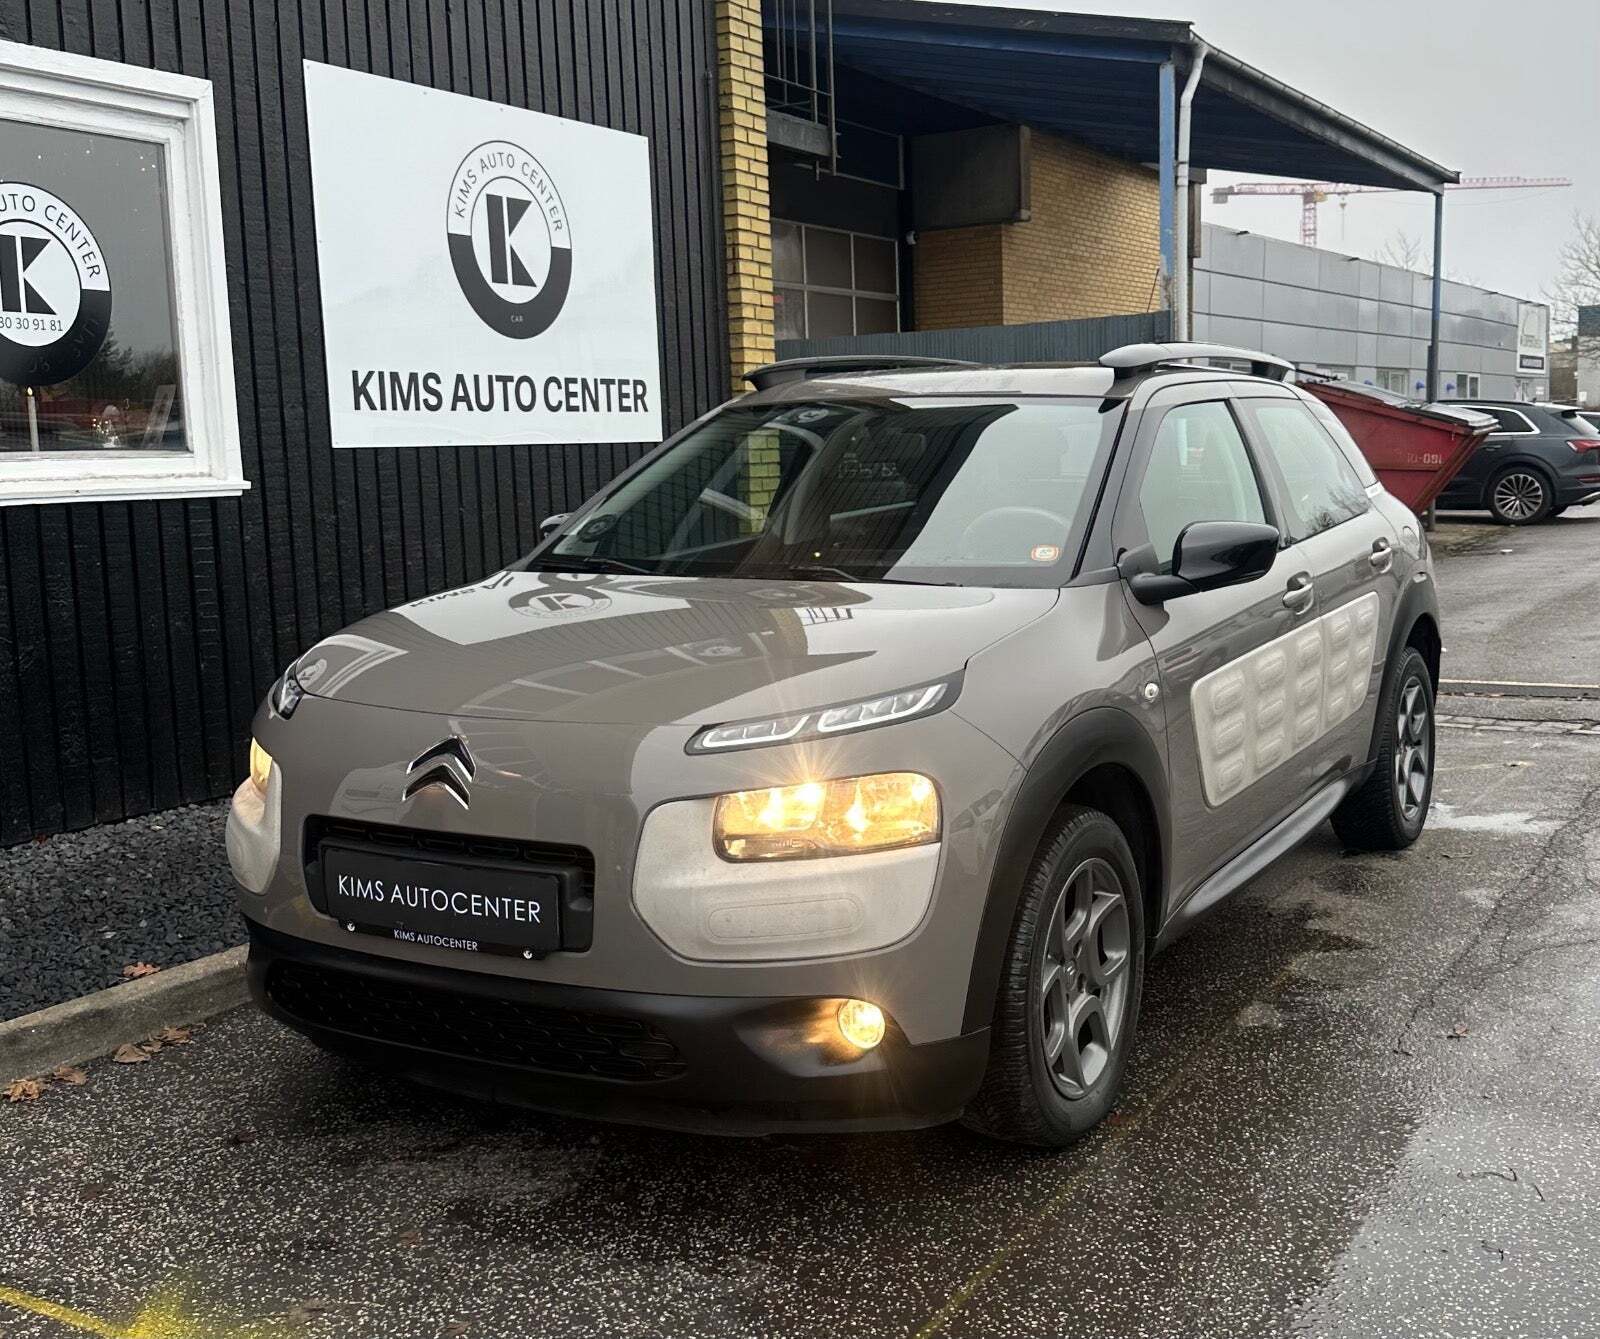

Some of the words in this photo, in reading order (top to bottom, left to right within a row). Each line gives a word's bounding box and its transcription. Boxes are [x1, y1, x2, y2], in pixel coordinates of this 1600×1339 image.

[455, 169, 477, 218] KIMS
[480, 152, 515, 174] AUTO
[521, 162, 563, 232] CENTER
[44, 204, 101, 278] CENTER
[485, 193, 538, 288] K
[15, 317, 30, 330] 30
[32, 318, 46, 331] 91
[50, 319, 63, 332] 81
[351, 370, 443, 412] KIMS
[450, 373, 537, 412] AUTO
[543, 376, 649, 413] CENTER
[338, 874, 384, 902] KIMS
[390, 884, 541, 924] AUTOCENTER
[393, 929, 415, 943] KIMS
[417, 934, 478, 951] AUTOCENTER
